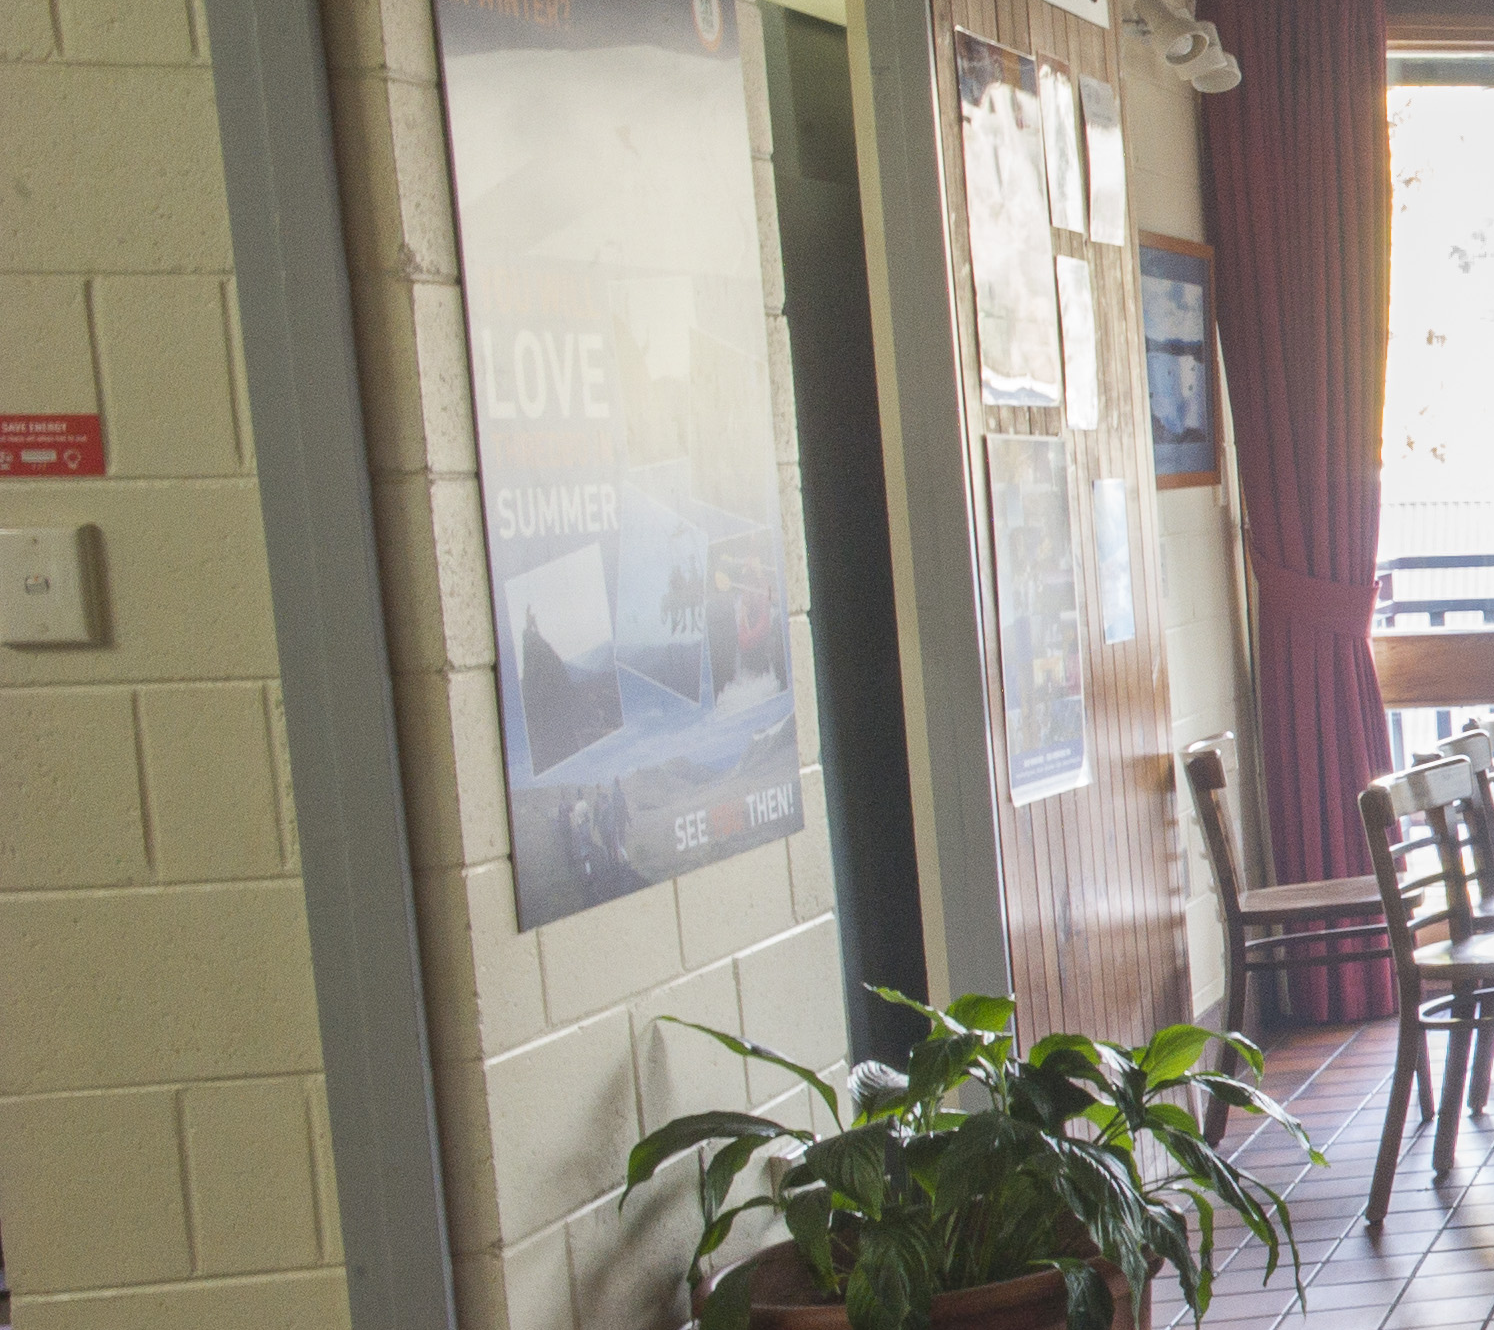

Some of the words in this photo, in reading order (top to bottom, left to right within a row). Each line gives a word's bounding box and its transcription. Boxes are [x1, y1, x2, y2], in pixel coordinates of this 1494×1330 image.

[481, 328, 611, 420] LOVE
[497, 483, 620, 540] SUMMER
[674, 810, 709, 852] SEE
[745, 783, 795, 827] THEN!
